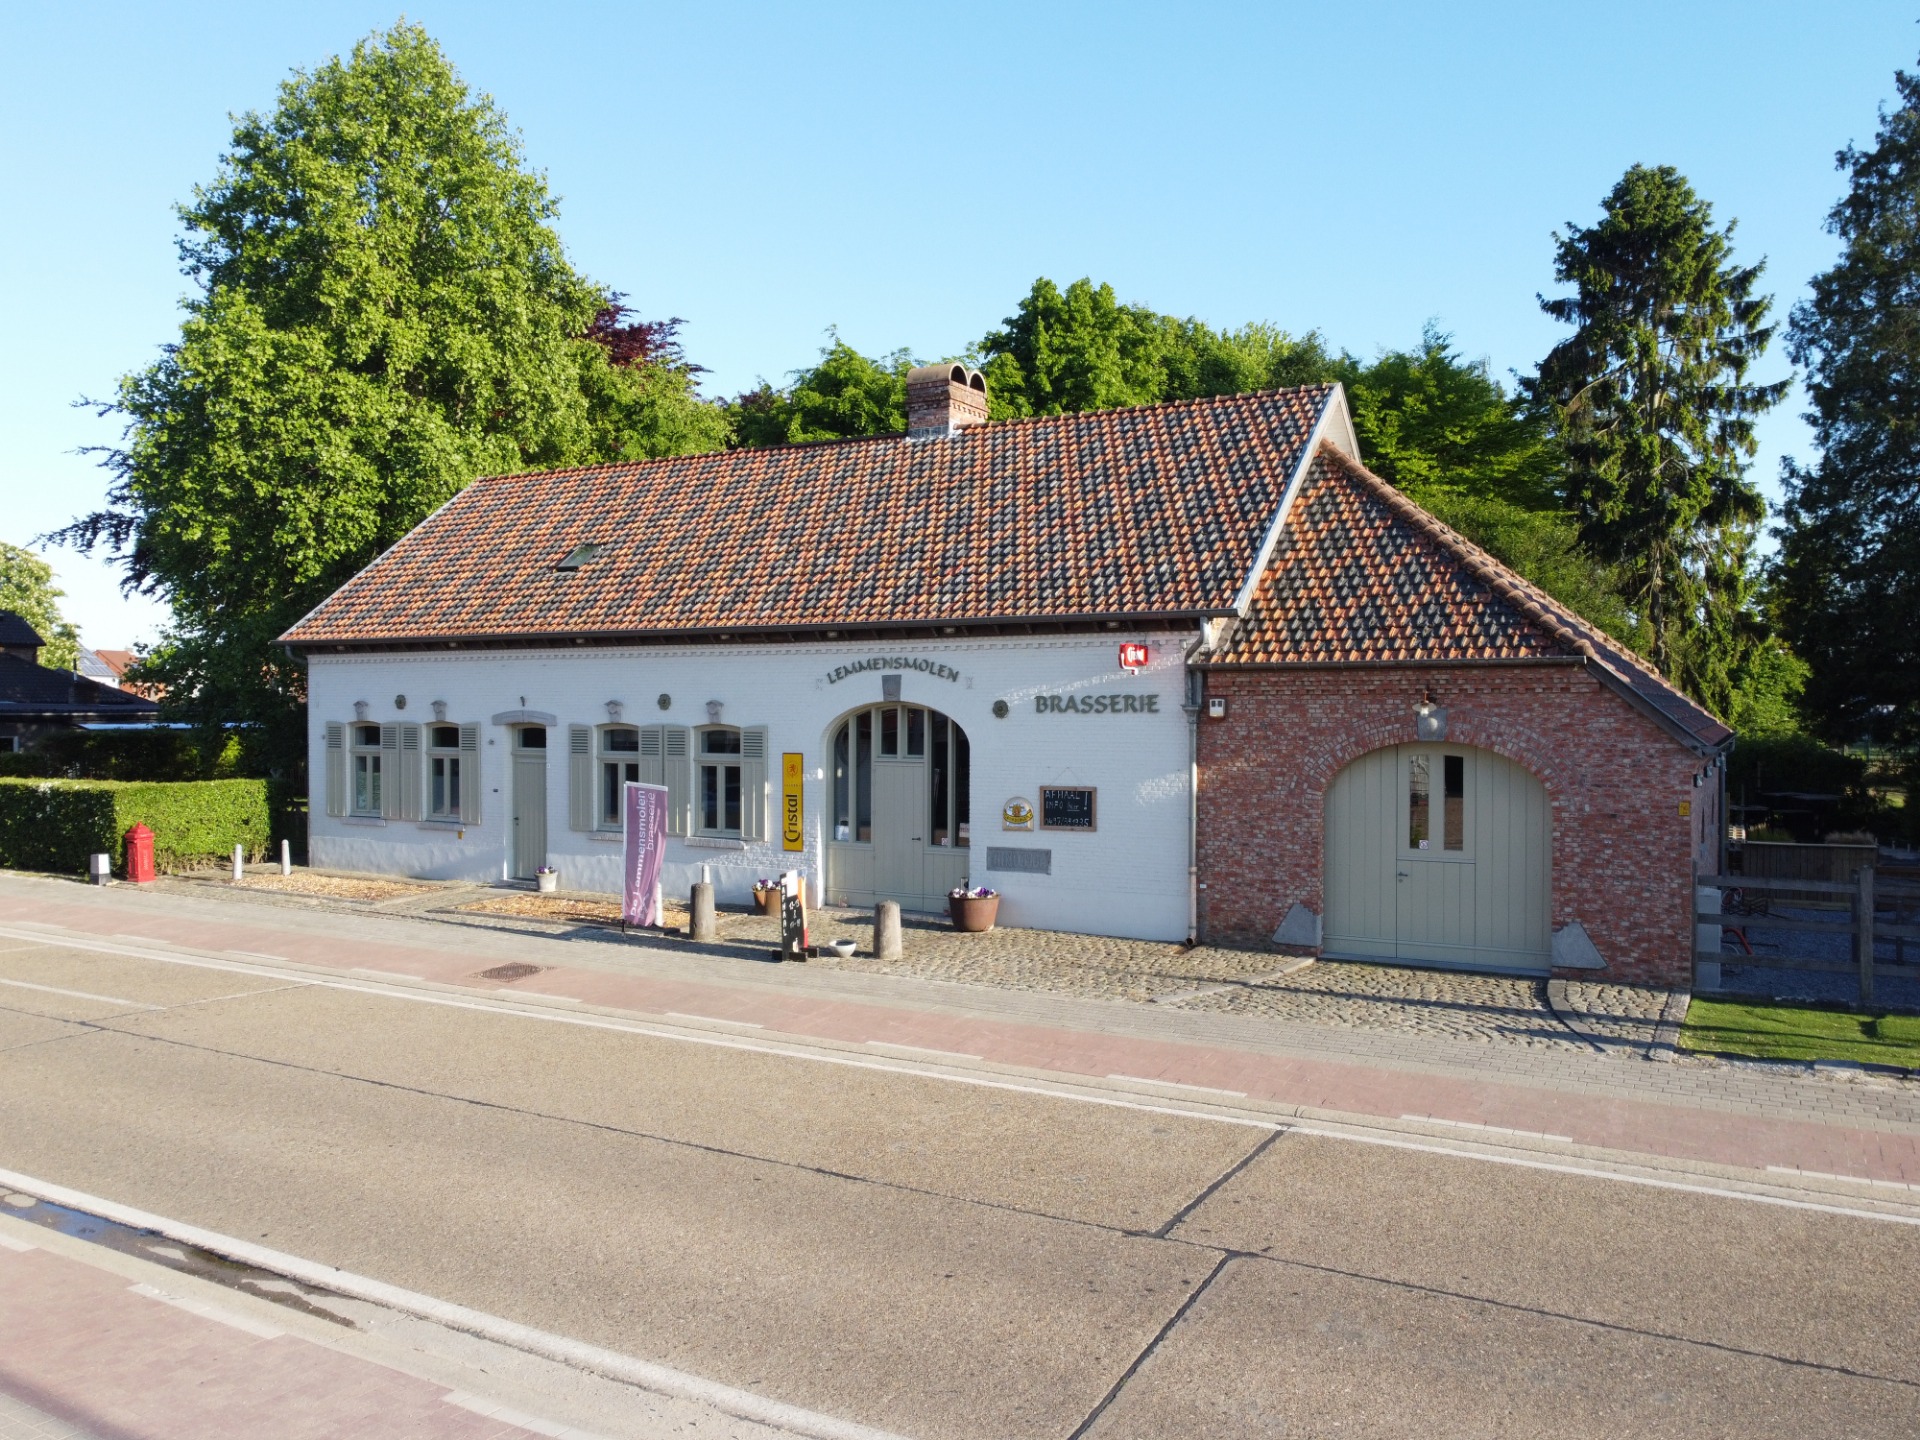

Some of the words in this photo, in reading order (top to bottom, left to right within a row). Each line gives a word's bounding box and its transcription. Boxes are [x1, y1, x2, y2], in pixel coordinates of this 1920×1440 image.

[826, 656, 960, 684] LEMMENSMOLEN
[1033, 694, 1160, 714] BRASSERIE
[645, 792, 656, 851] brasserie
[783, 794, 801, 843] Cristal
